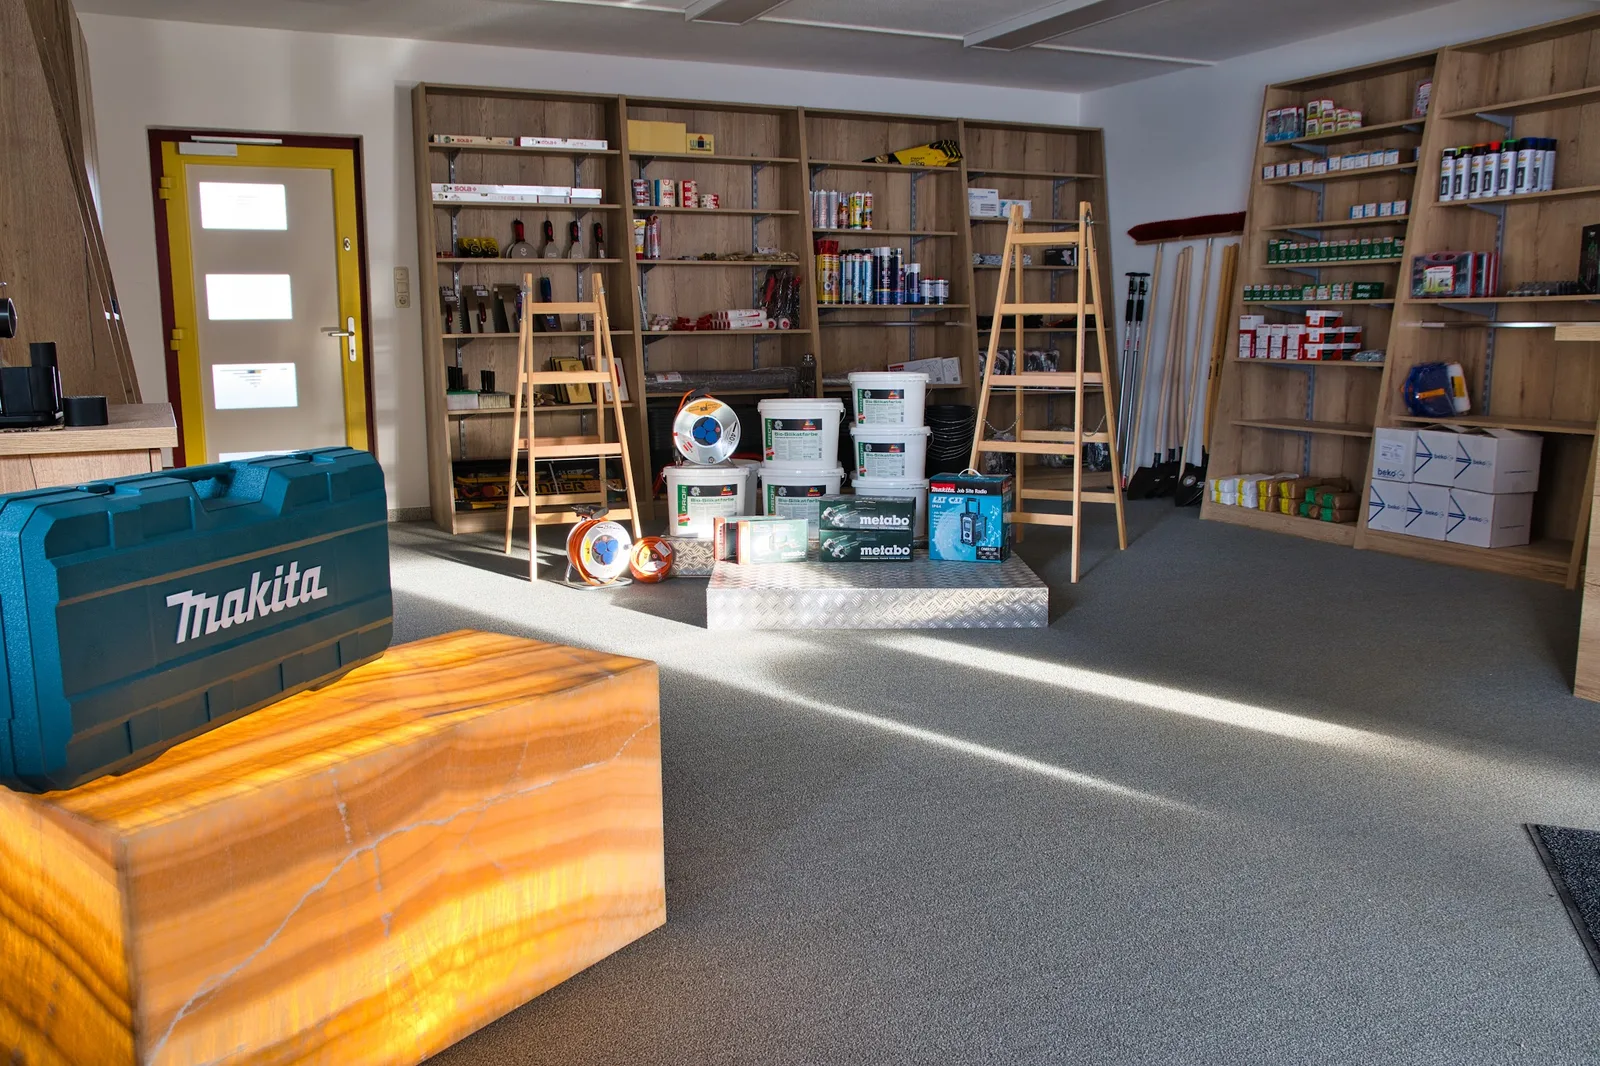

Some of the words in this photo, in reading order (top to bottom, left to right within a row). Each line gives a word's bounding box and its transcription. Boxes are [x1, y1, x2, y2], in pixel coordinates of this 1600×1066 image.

[1377, 467, 1396, 477] beko
[860, 515, 909, 525] metabo
[861, 545, 910, 555] metabo
[166, 561, 328, 644] Makita
